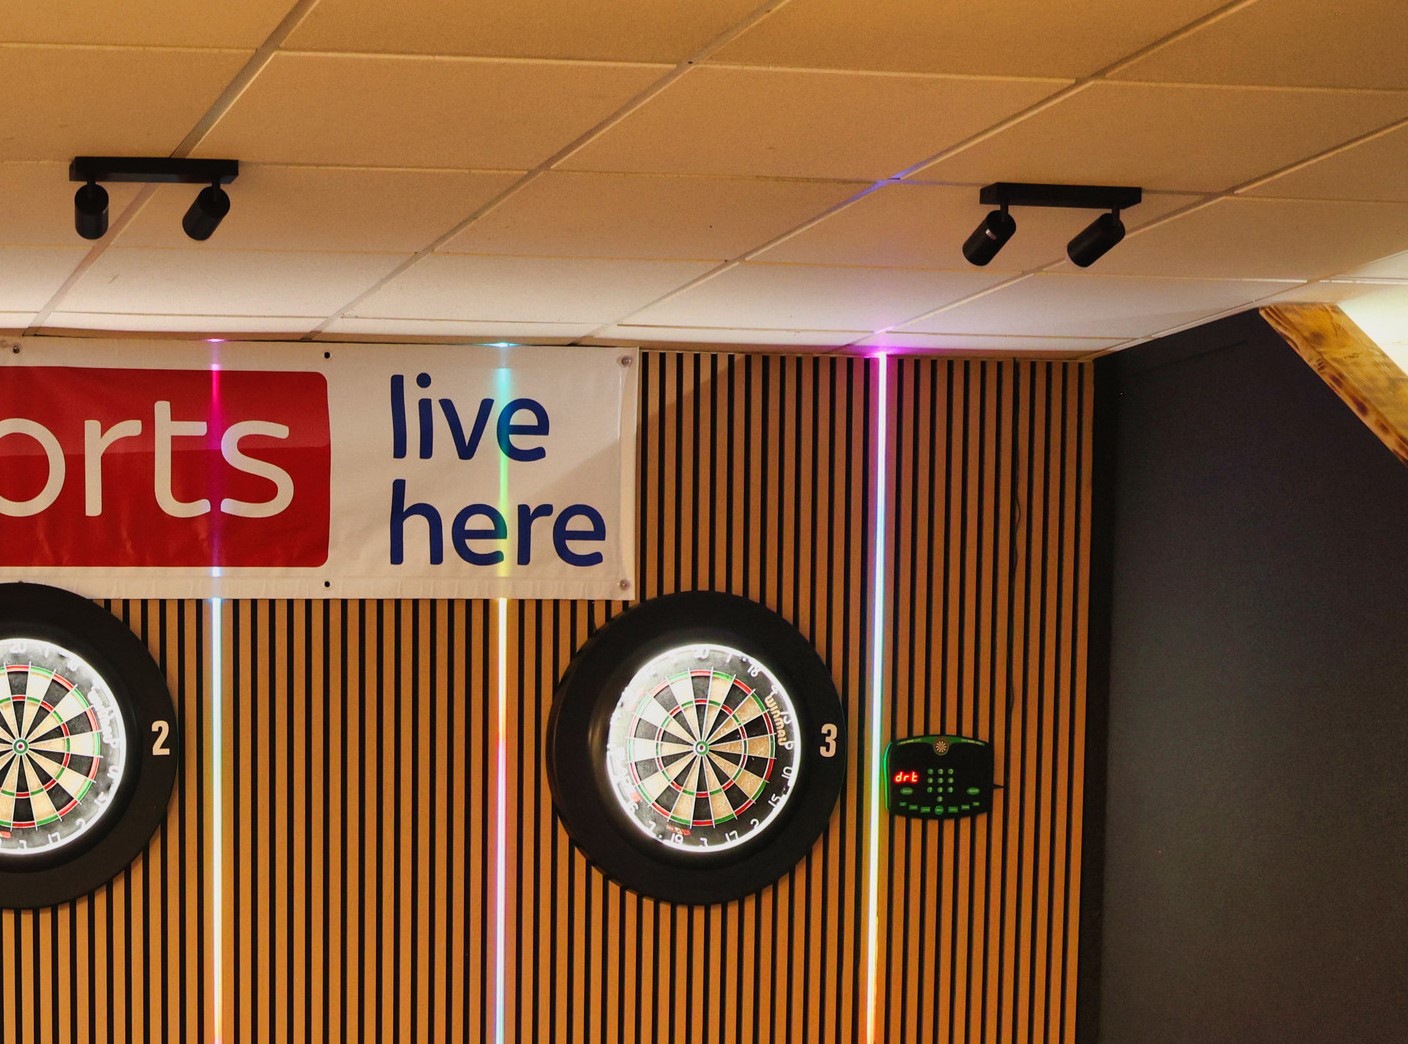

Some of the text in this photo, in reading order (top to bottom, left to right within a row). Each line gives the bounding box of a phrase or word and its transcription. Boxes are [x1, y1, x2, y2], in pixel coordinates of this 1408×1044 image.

[390, 372, 550, 461] live
[390, 479, 606, 566] here
[151, 720, 171, 756] 2
[819, 723, 838, 758] 3
[895, 772, 918, 783] drt
[768, 793, 781, 807] 15
[750, 818, 760, 830] 2
[671, 833, 684, 844] 19
[724, 830, 739, 842] 17
